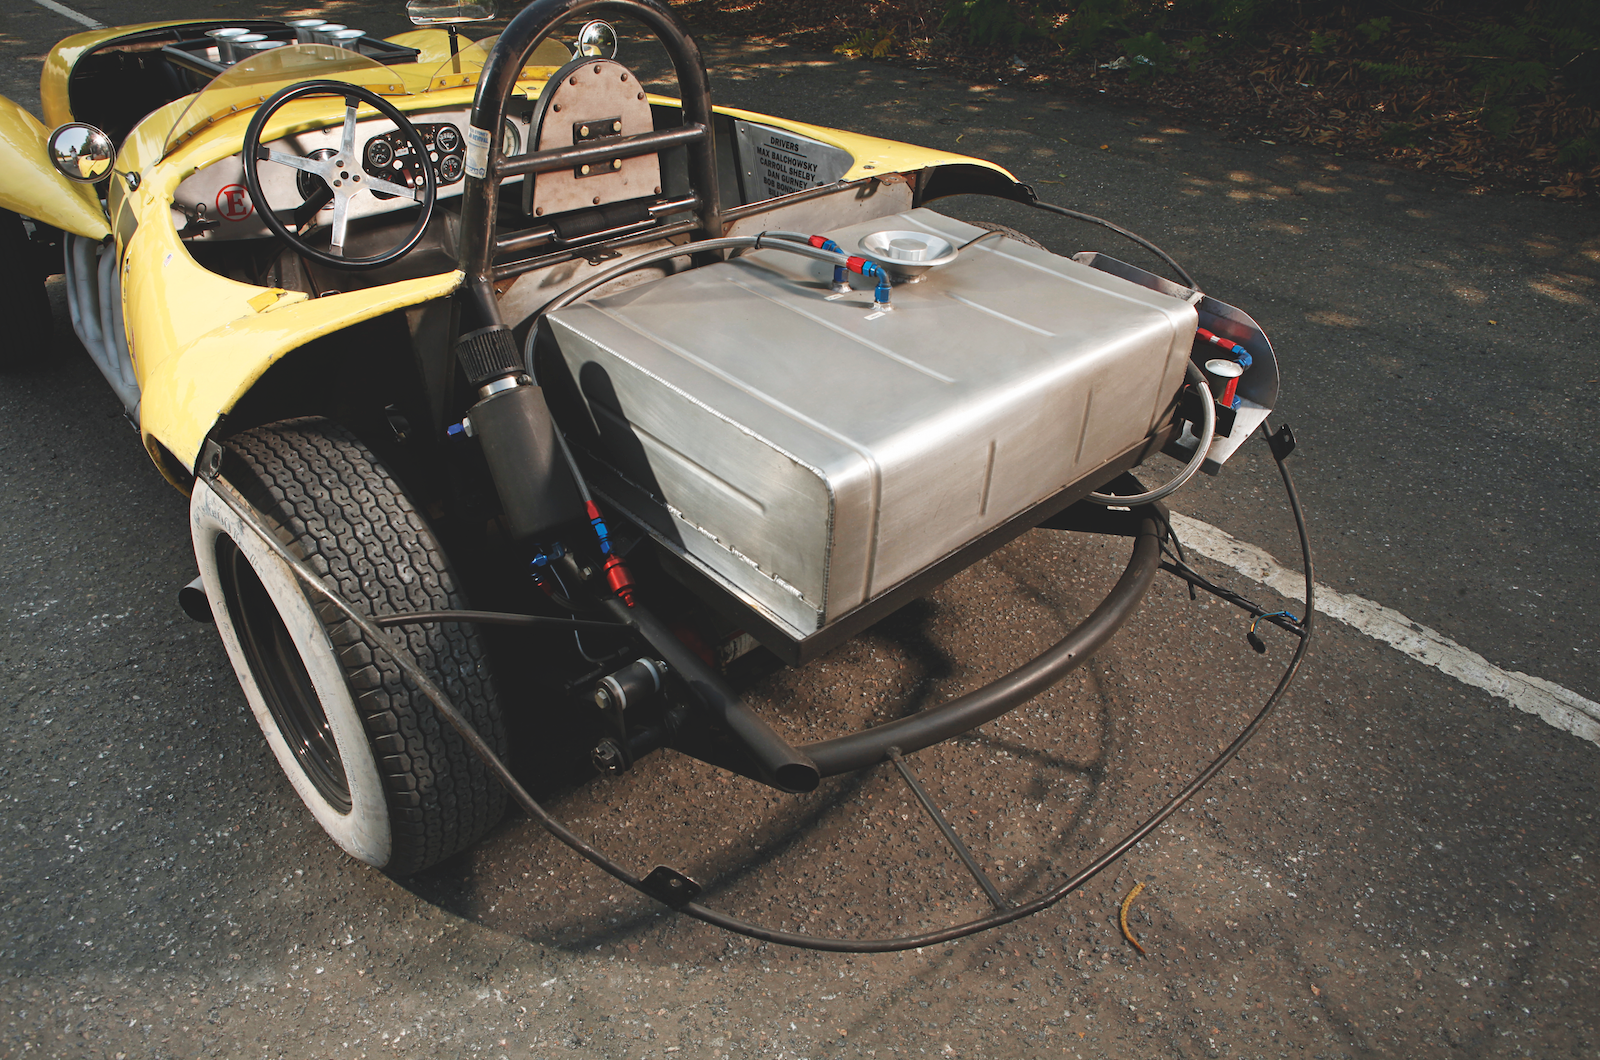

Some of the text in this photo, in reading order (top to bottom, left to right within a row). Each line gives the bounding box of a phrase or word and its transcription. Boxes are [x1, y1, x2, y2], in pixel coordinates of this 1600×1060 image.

[770, 137, 799, 151] DRIVERS
[756, 147, 818, 172] MAX BALCHOWSKY
[760, 157, 815, 182] CARROLL SHELBY
[764, 177, 775, 187] BOB
[768, 169, 807, 190] DAN GURNEY
[223, 189, 247, 217] E
